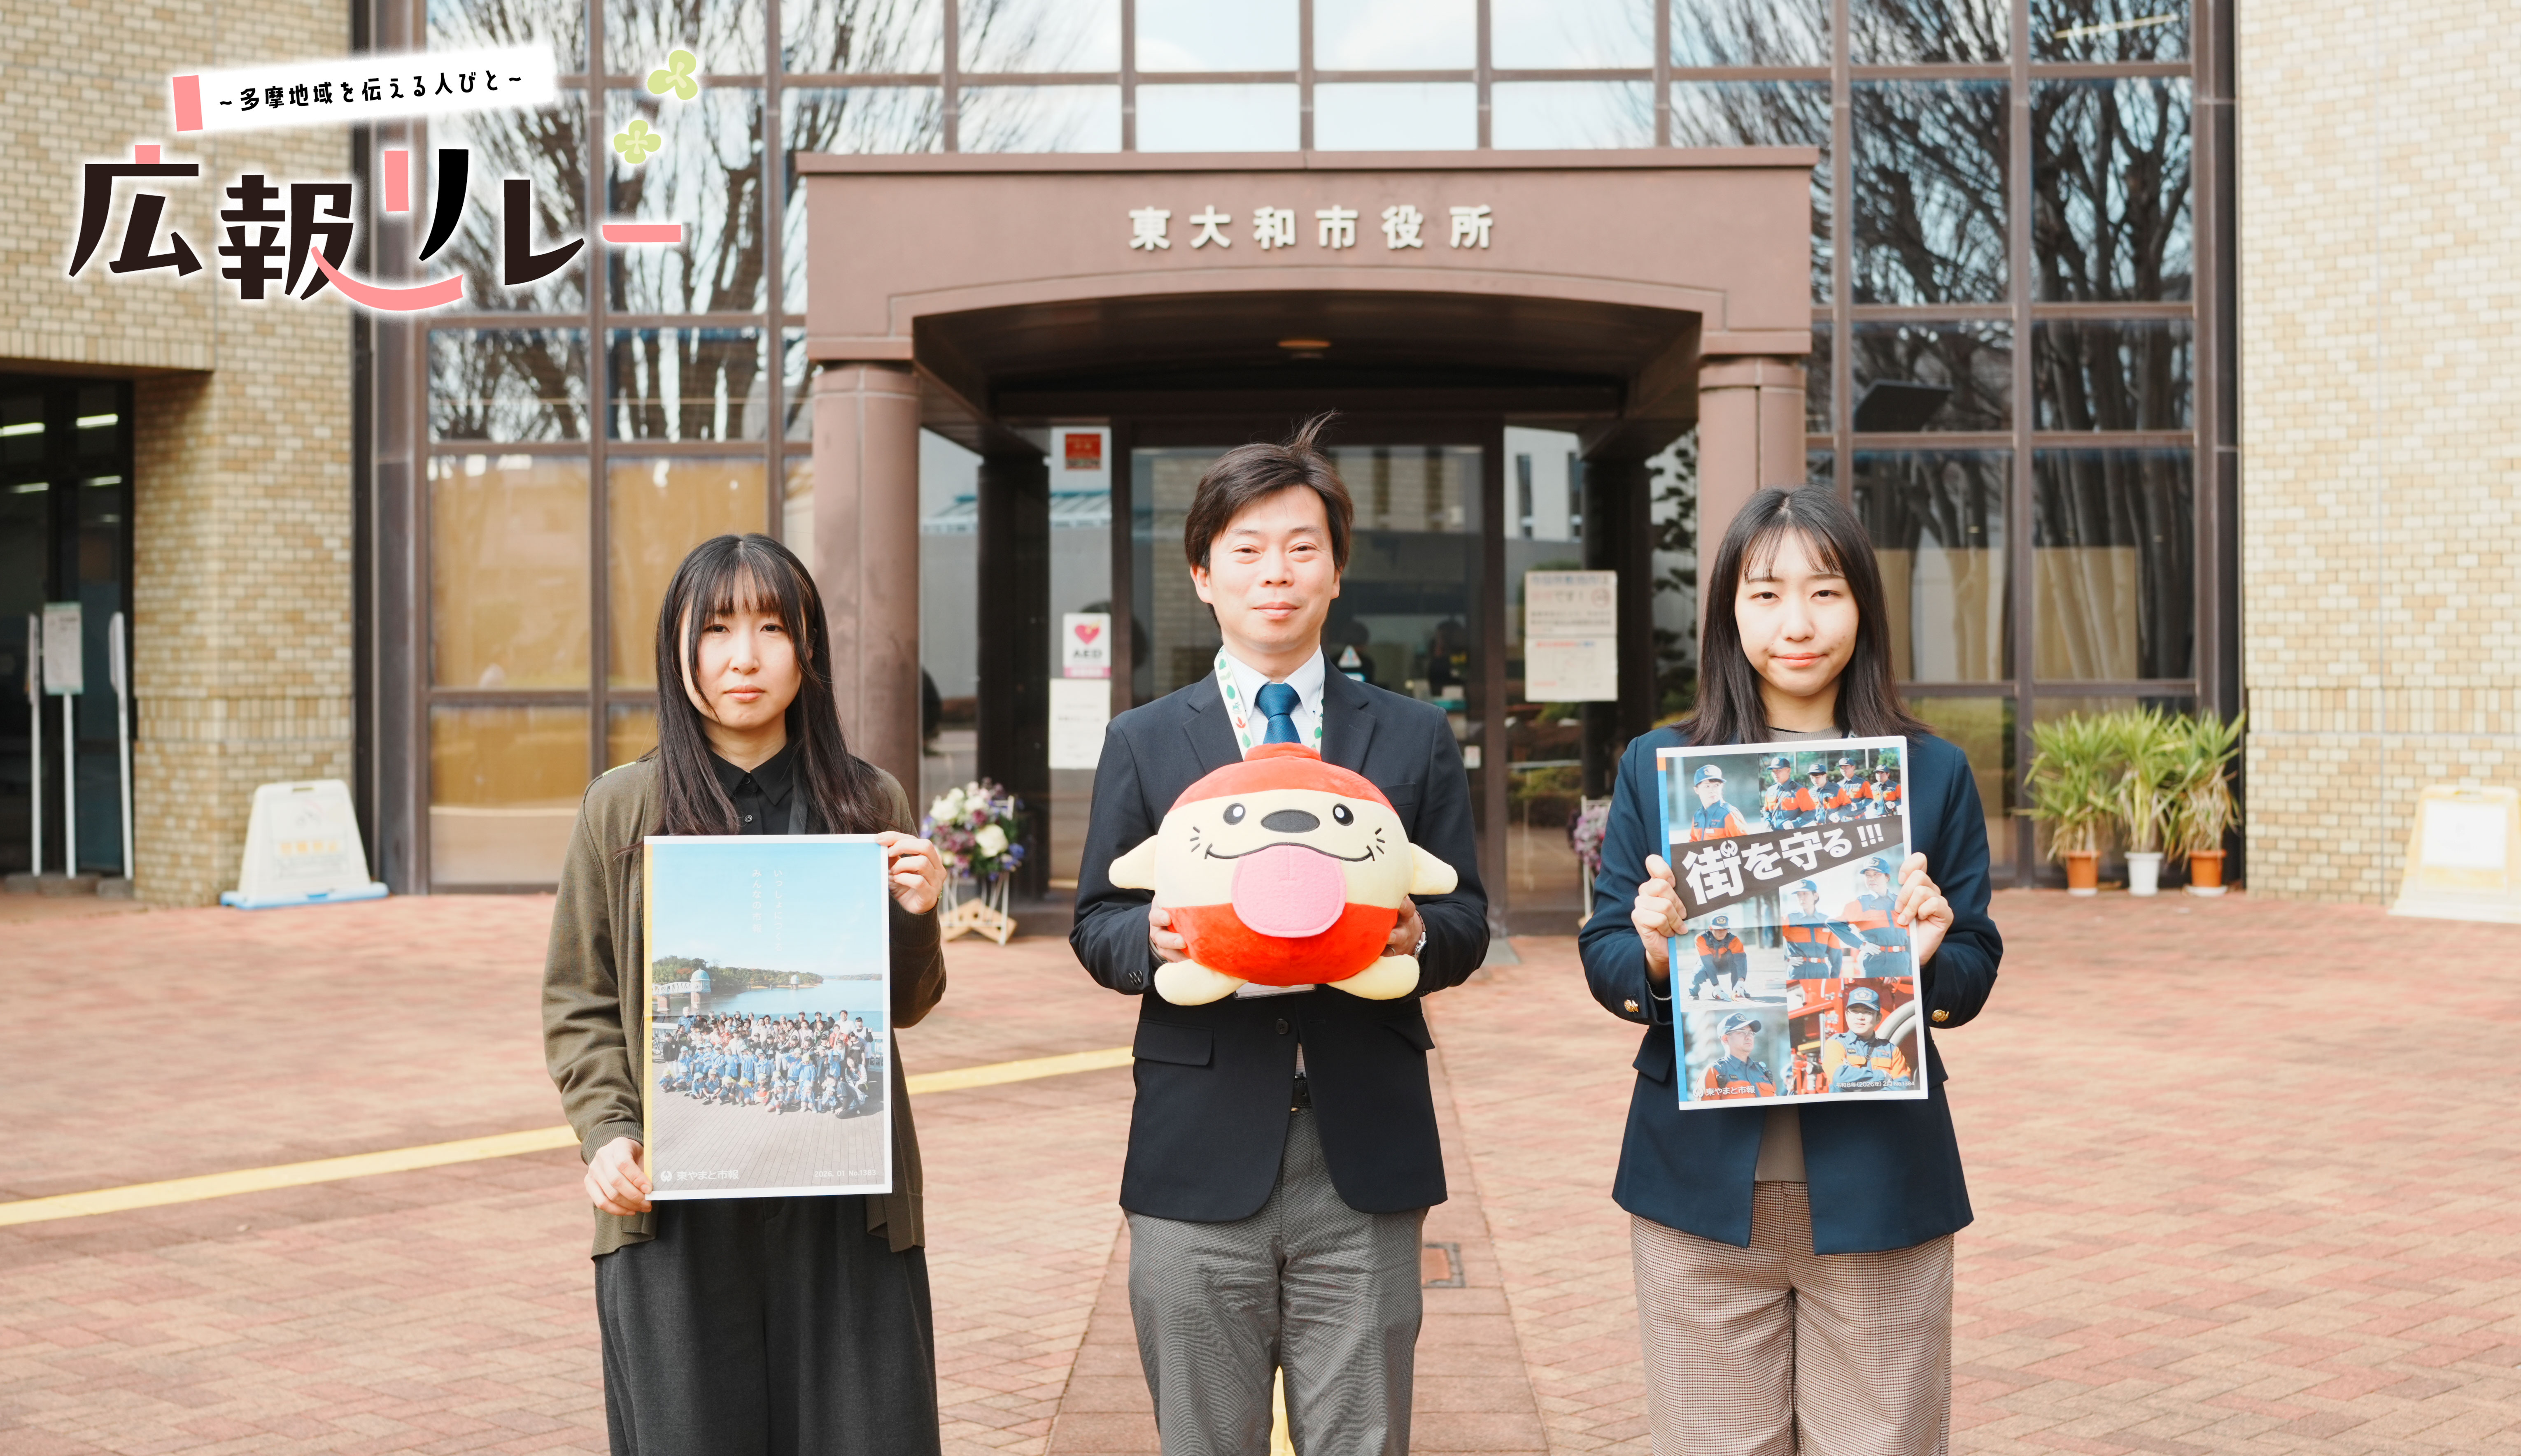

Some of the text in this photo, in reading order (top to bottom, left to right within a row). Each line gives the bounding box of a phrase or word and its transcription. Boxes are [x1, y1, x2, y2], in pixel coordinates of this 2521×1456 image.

[1129, 205, 1492, 250] 東大和市役所
[752, 869, 762, 933] みんなの市報
[774, 869, 783, 951] いっしょにつくる
[1706, 1085, 1756, 1096] 東やまと市報
[676, 1169, 739, 1181] 東やまと市報
